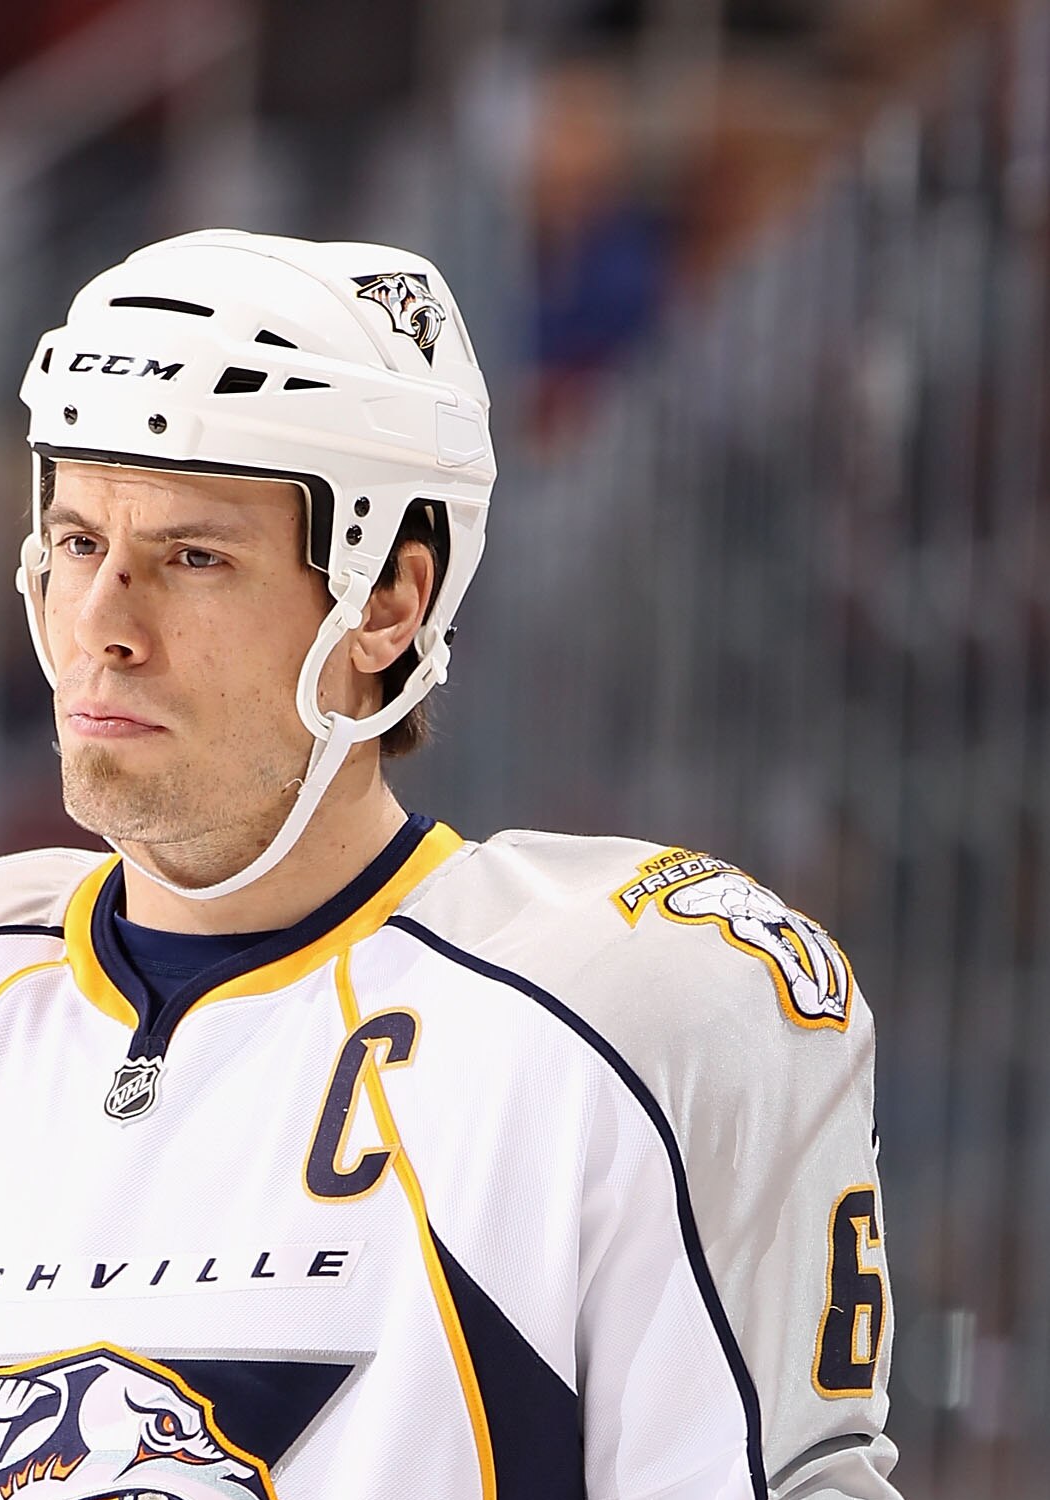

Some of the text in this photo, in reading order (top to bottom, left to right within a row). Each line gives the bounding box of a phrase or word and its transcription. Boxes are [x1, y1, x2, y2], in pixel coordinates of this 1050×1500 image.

[67, 352, 185, 382] CCM
[303, 1006, 422, 1205] C
[812, 1183, 887, 1400] 6
